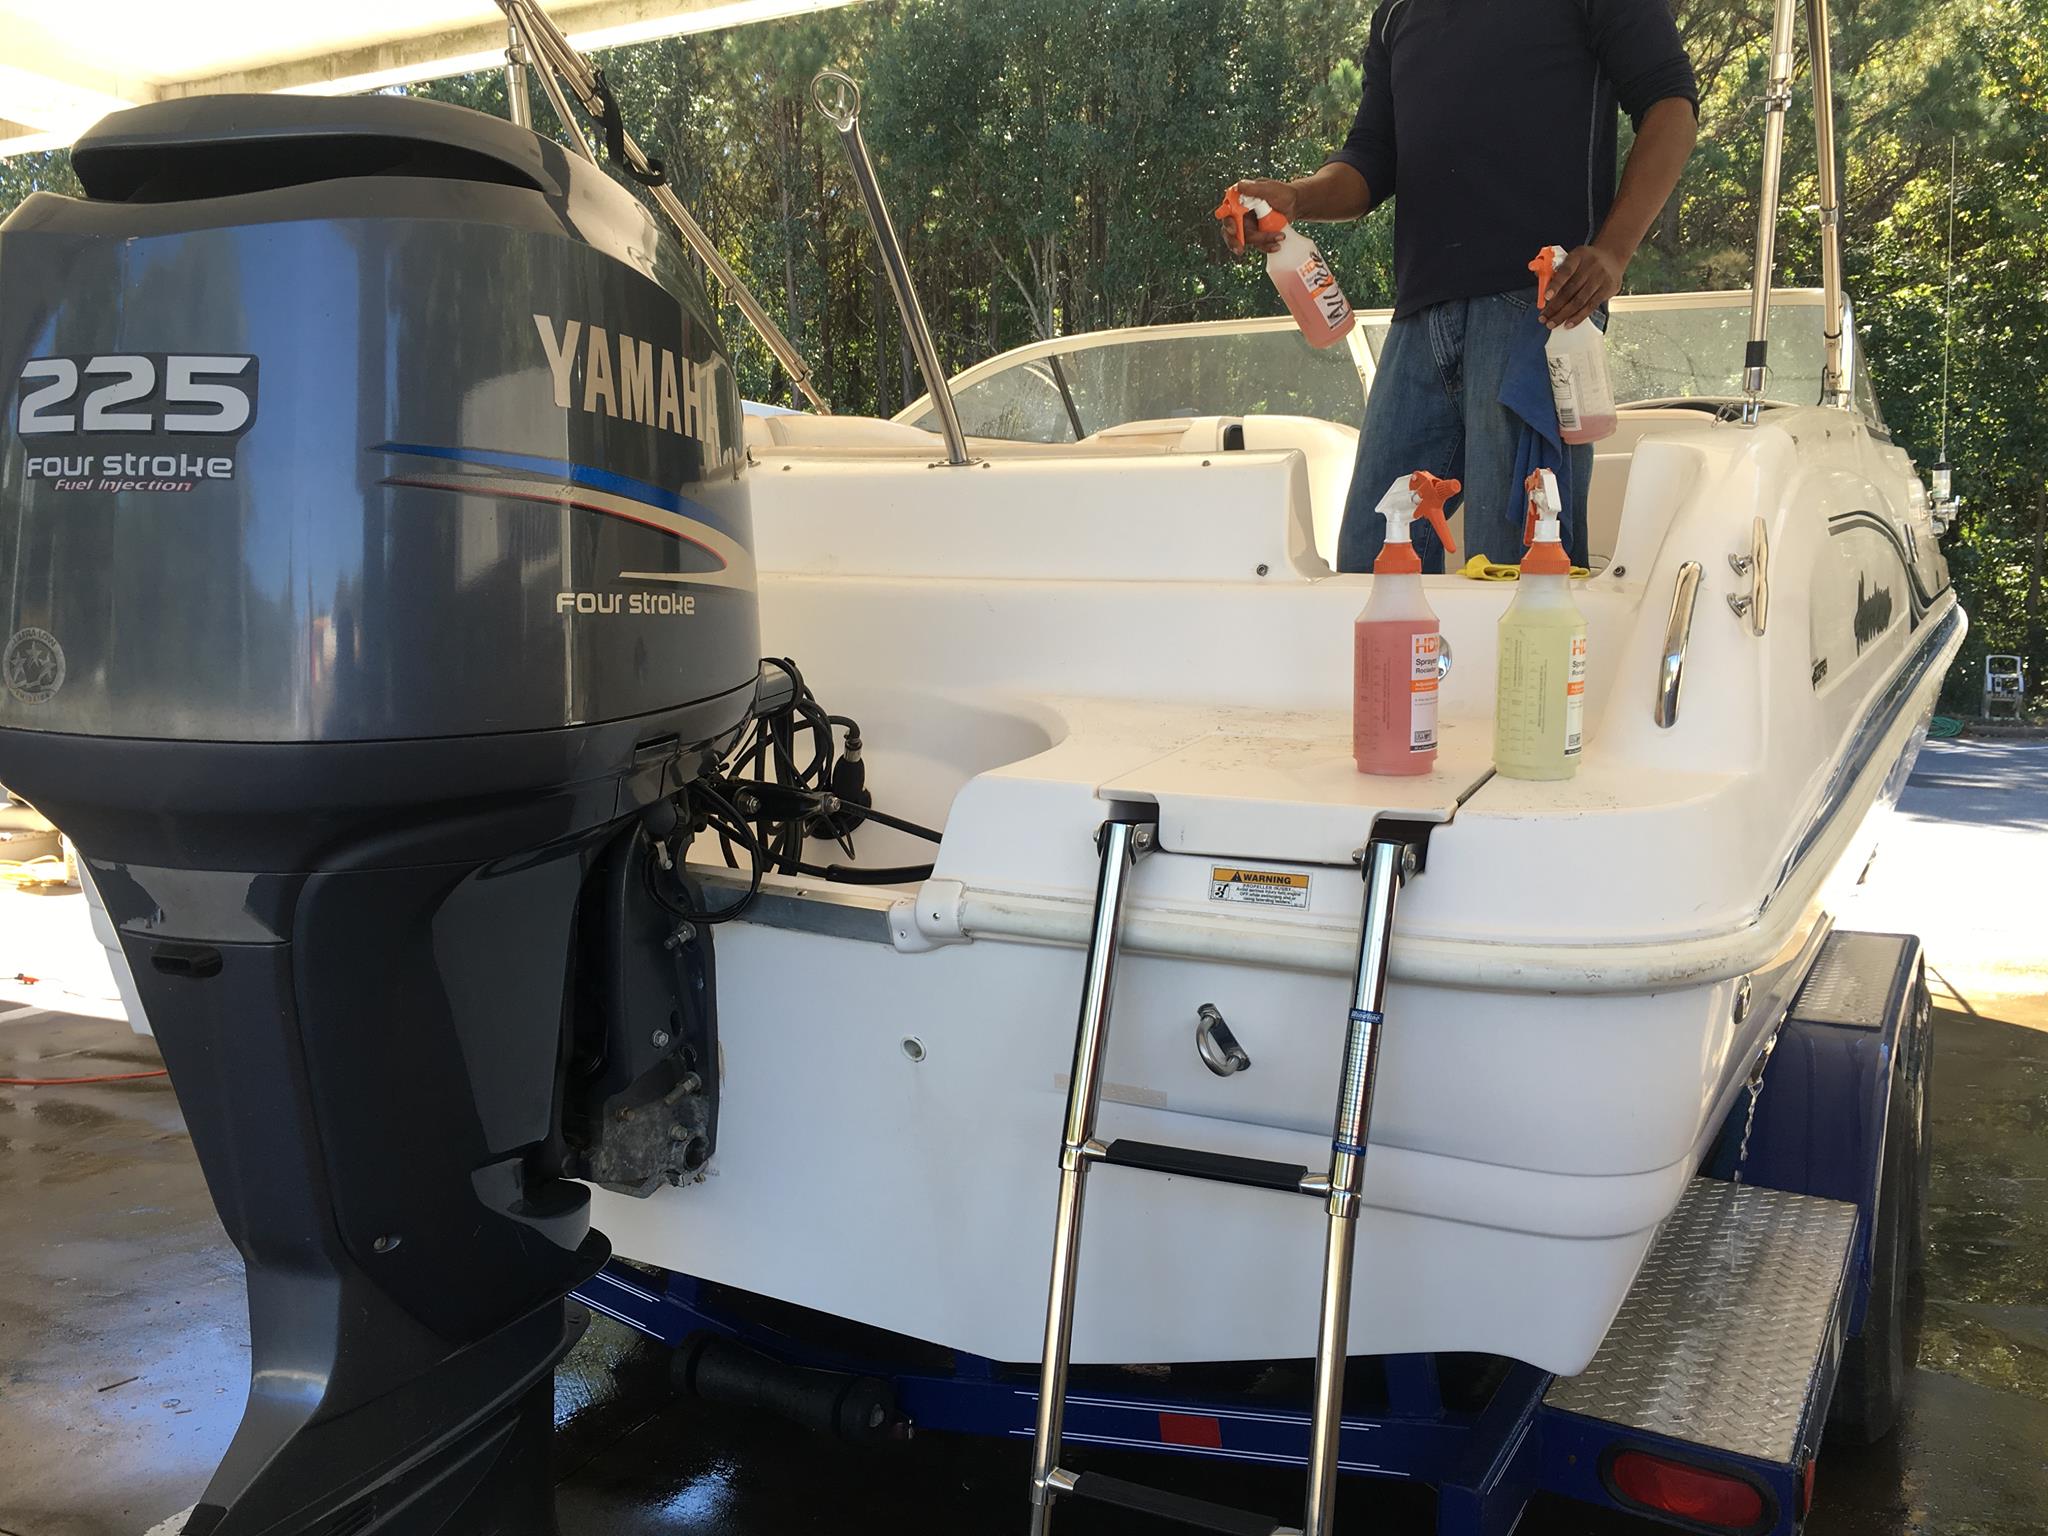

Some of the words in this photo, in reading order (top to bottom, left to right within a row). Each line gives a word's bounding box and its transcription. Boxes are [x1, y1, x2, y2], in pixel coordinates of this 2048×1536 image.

[18, 355, 251, 434] 225
[533, 314, 722, 452] YAMAHA
[54, 478, 93, 491] Fuel
[98, 479, 193, 493] Injection
[1243, 872, 1292, 885] WARNING
